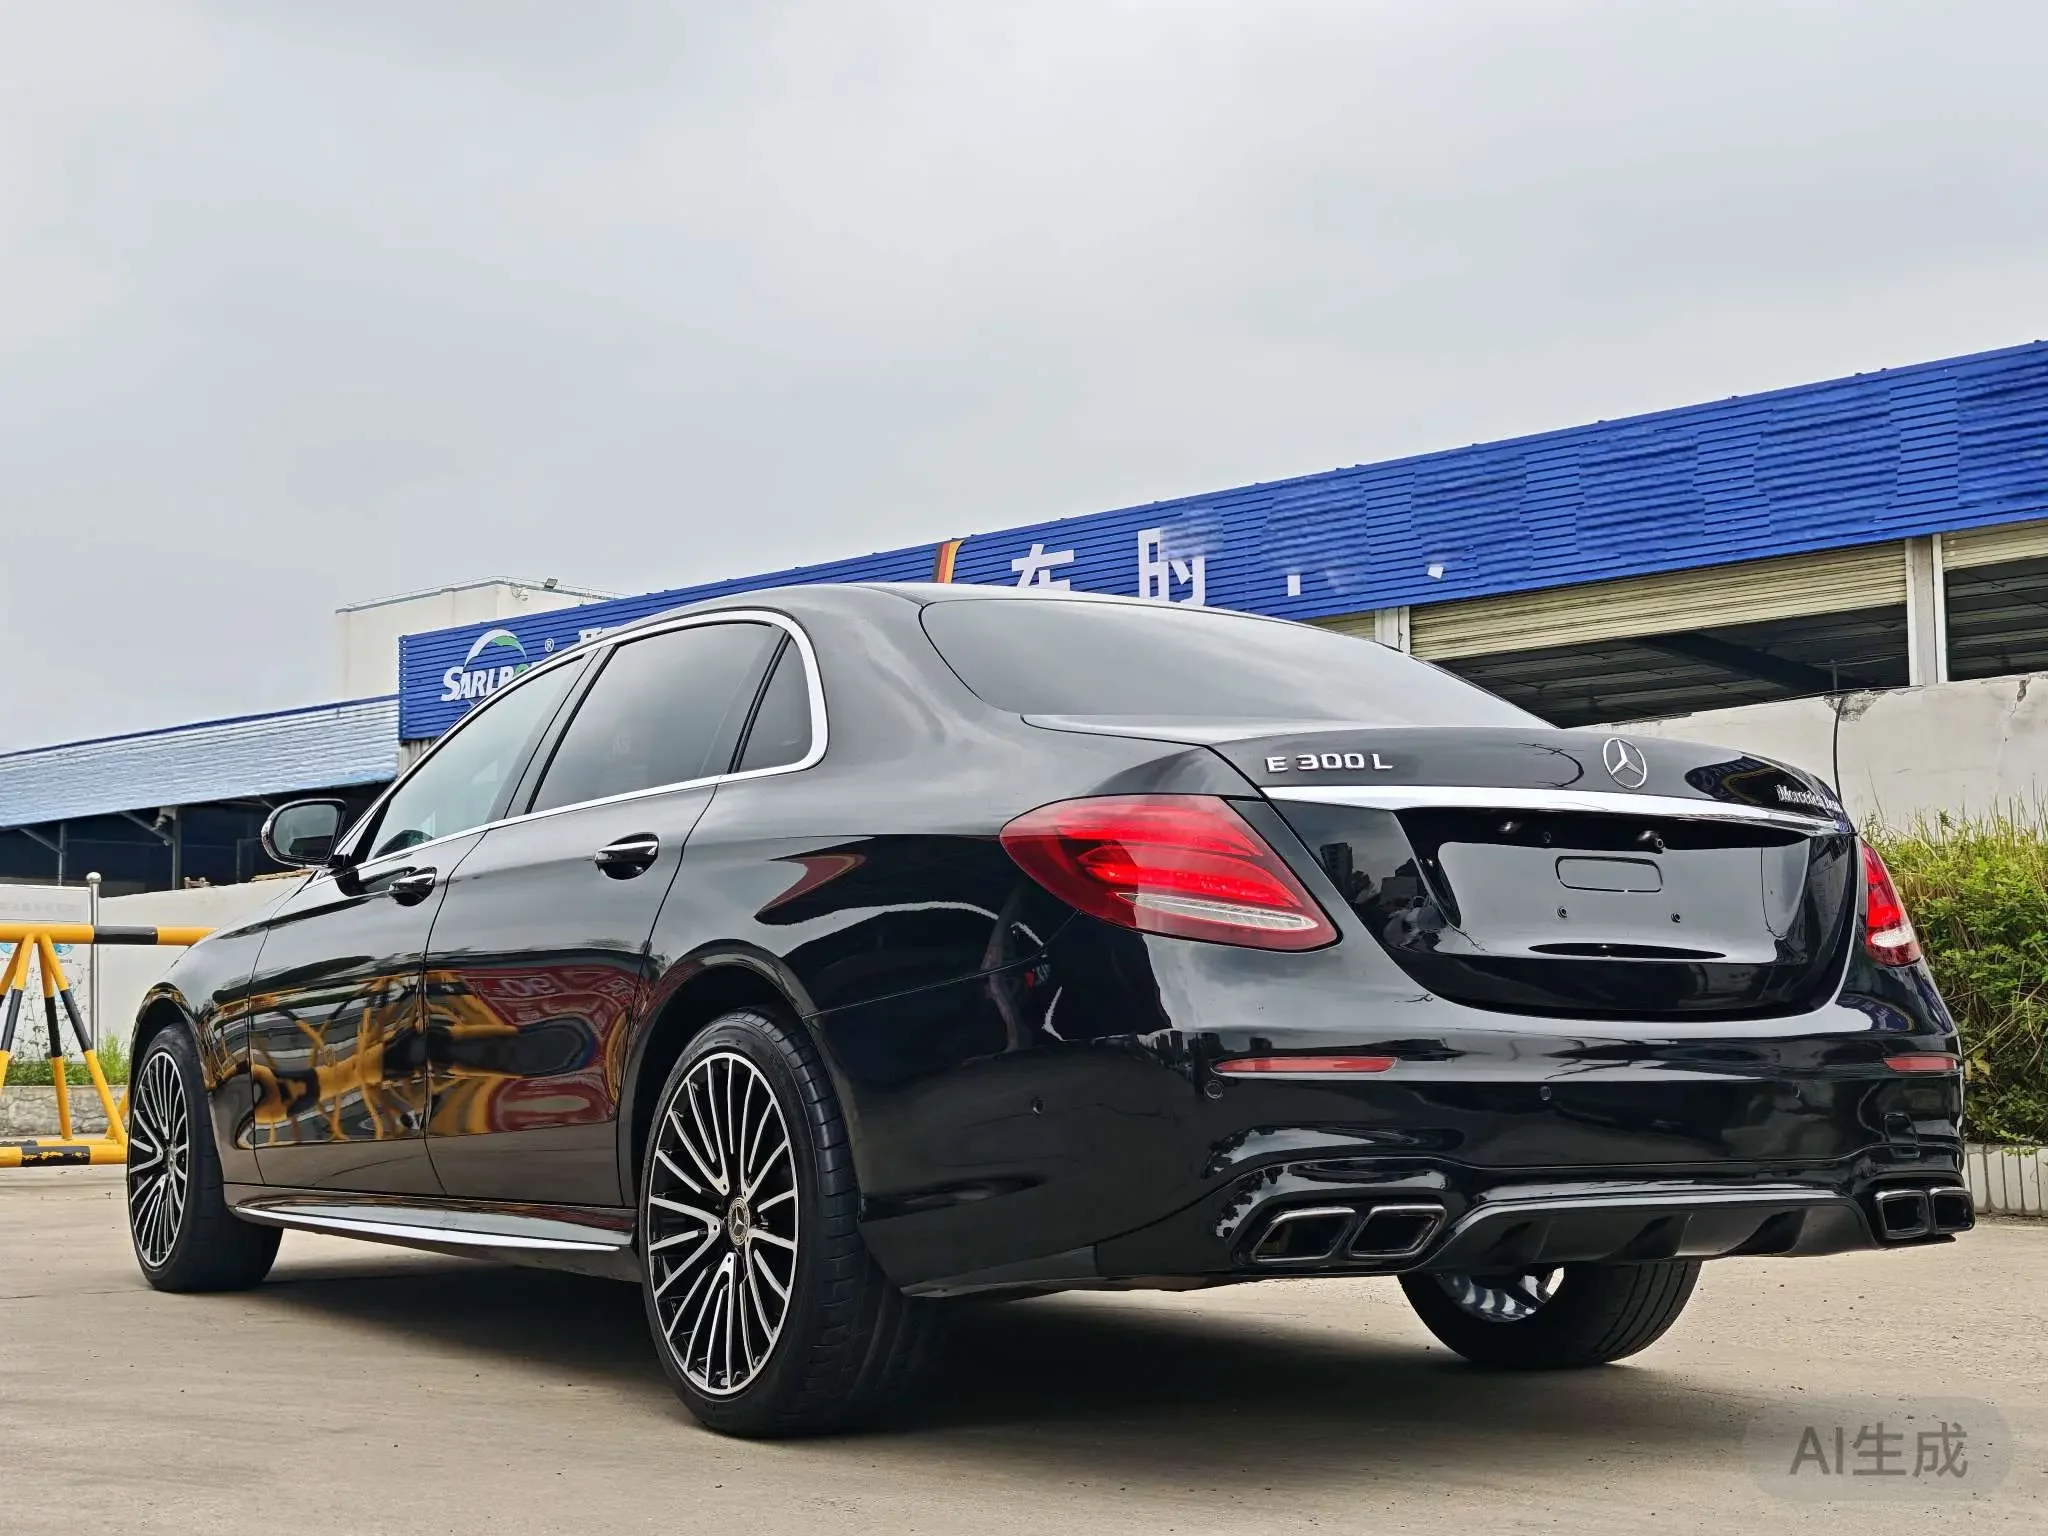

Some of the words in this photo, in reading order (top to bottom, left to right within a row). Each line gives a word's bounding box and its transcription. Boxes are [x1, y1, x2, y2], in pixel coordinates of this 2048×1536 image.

[1265, 756, 1289, 773] E
[1296, 753, 1366, 771] 300
[1371, 753, 1394, 770] L
